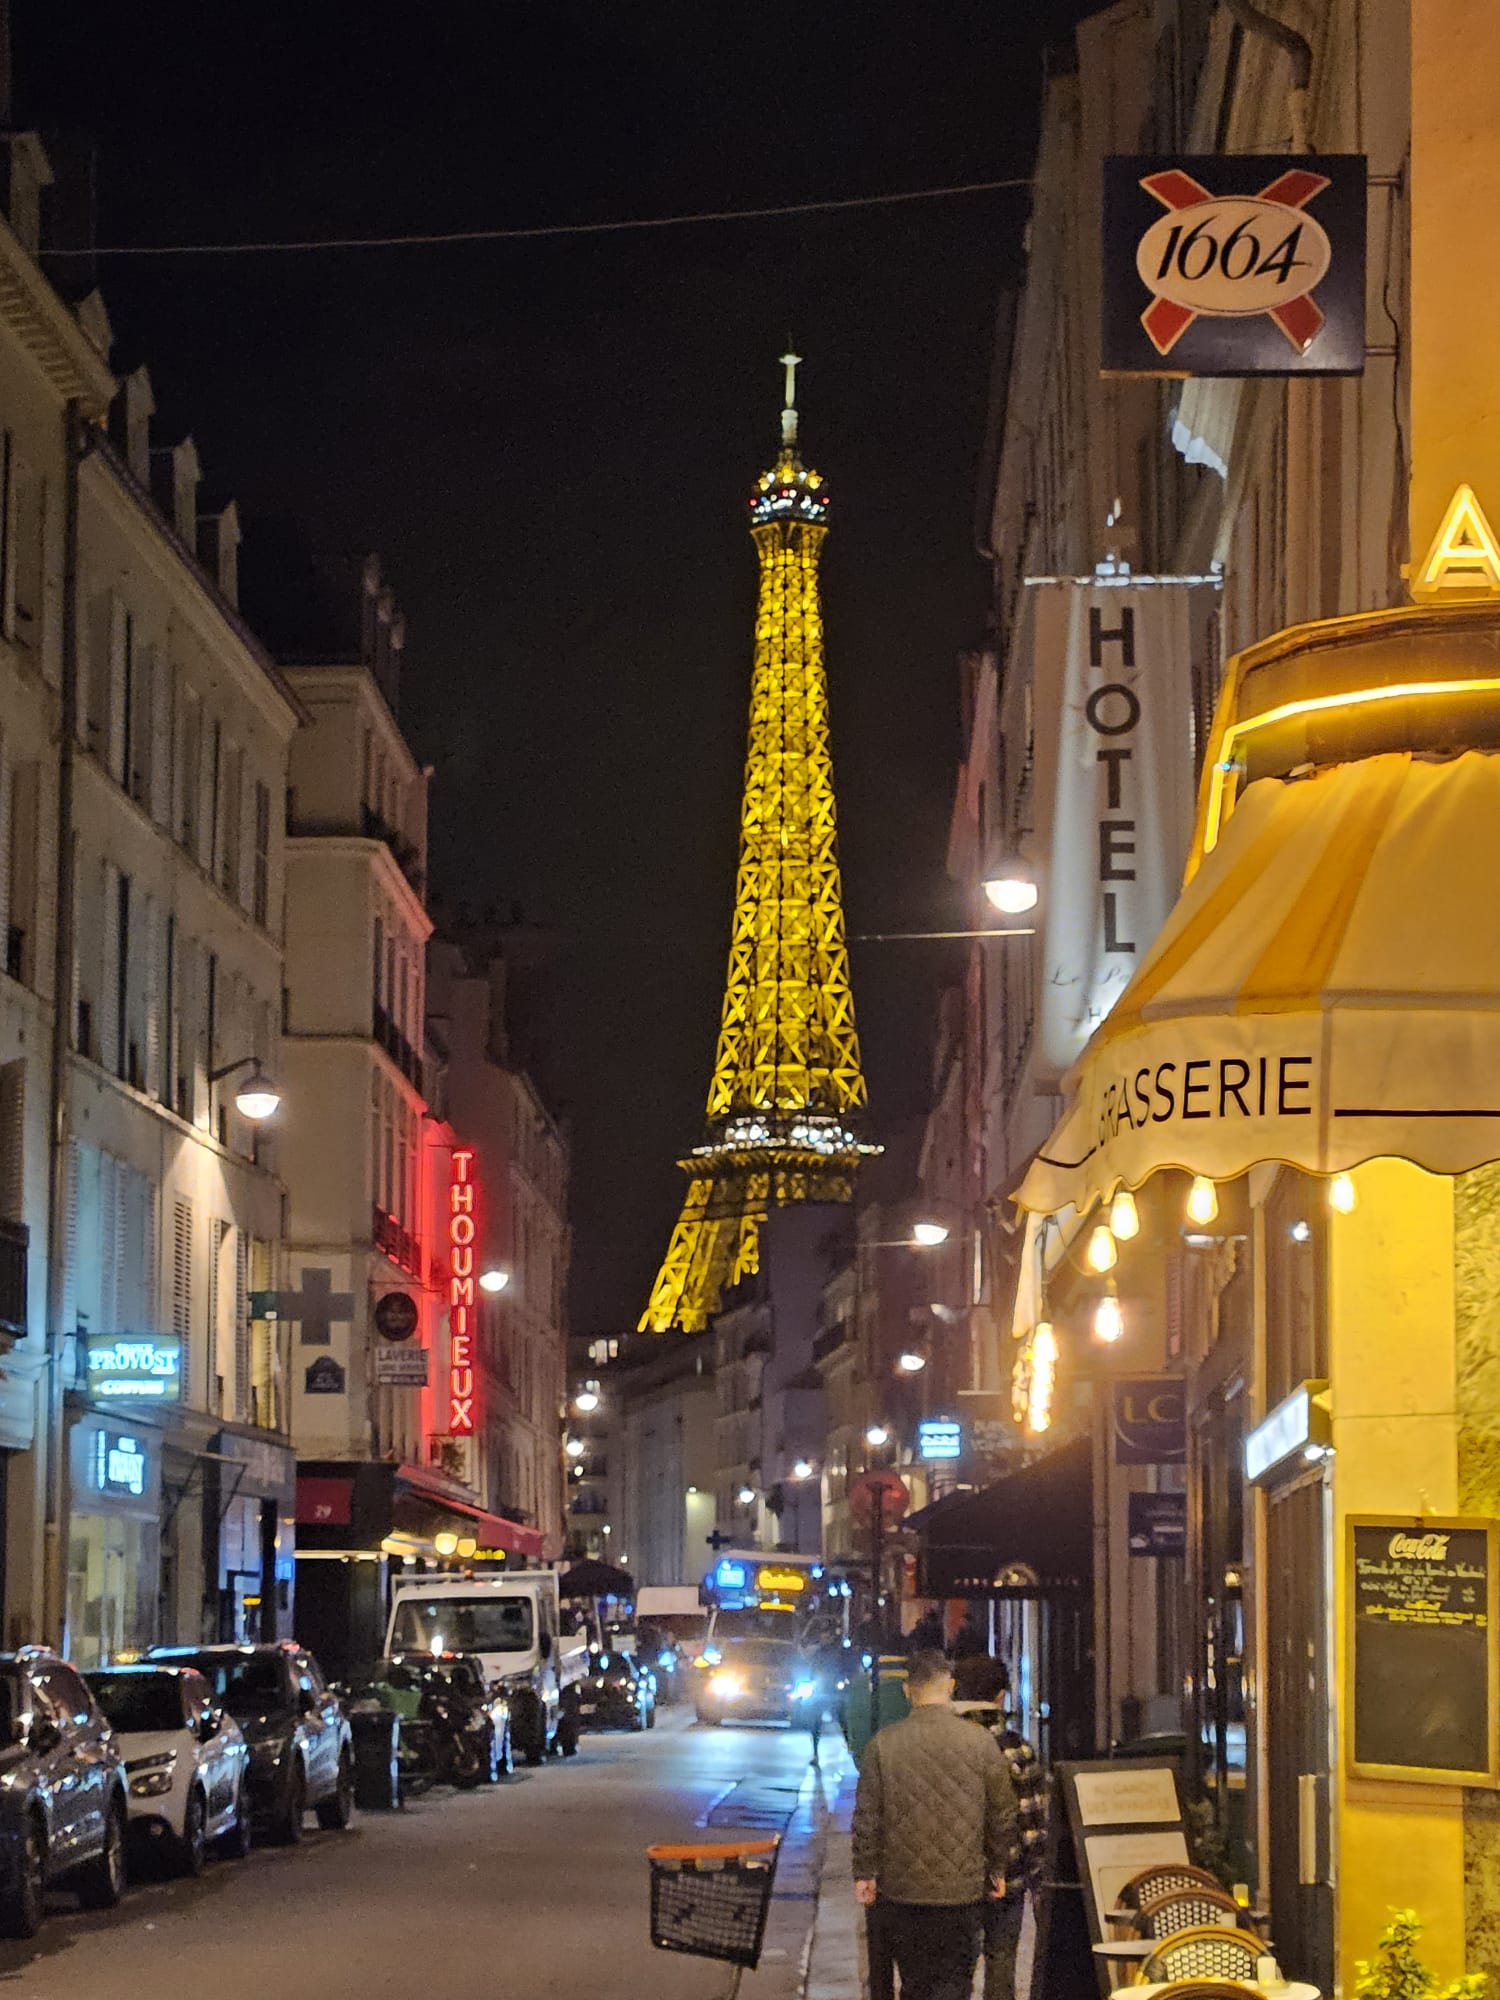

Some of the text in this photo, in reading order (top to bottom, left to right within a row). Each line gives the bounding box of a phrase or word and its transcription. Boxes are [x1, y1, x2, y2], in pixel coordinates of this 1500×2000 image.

[1156, 214, 1312, 285] 1664
[1086, 607, 1140, 953] HOTEL
[1097, 1056, 1313, 1148] BRASSERIE
[450, 1152, 474, 1430] THOUMIEUX
[88, 1350, 179, 1373] PROVOST
[1124, 1394, 1180, 1424] LC
